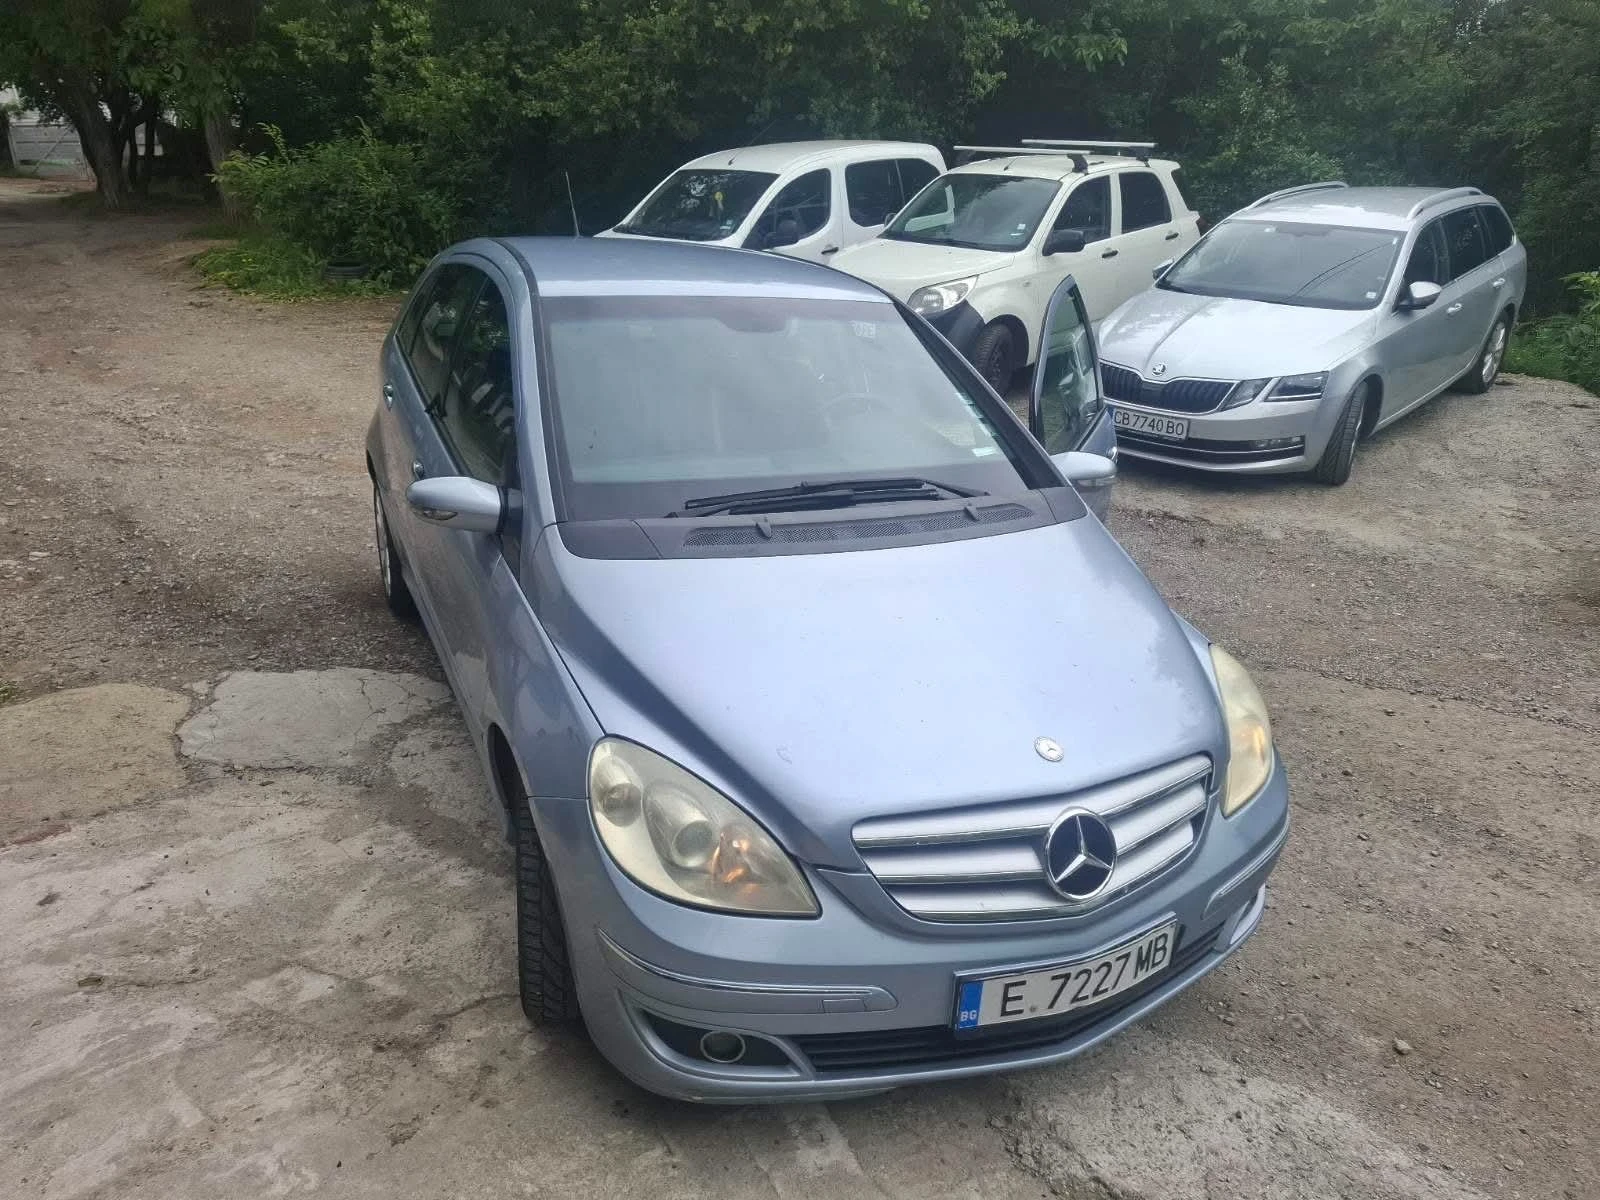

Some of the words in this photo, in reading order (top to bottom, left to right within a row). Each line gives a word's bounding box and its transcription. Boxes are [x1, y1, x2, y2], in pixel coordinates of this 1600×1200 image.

[1114, 410, 1130, 426] CB
[1132, 414, 1164, 432] 7740
[1166, 420, 1184, 436] BO
[1000, 979, 1027, 1017] E
[1047, 951, 1131, 1010] 7227
[1133, 932, 1169, 979] MB
[960, 1009, 977, 1022] BG
